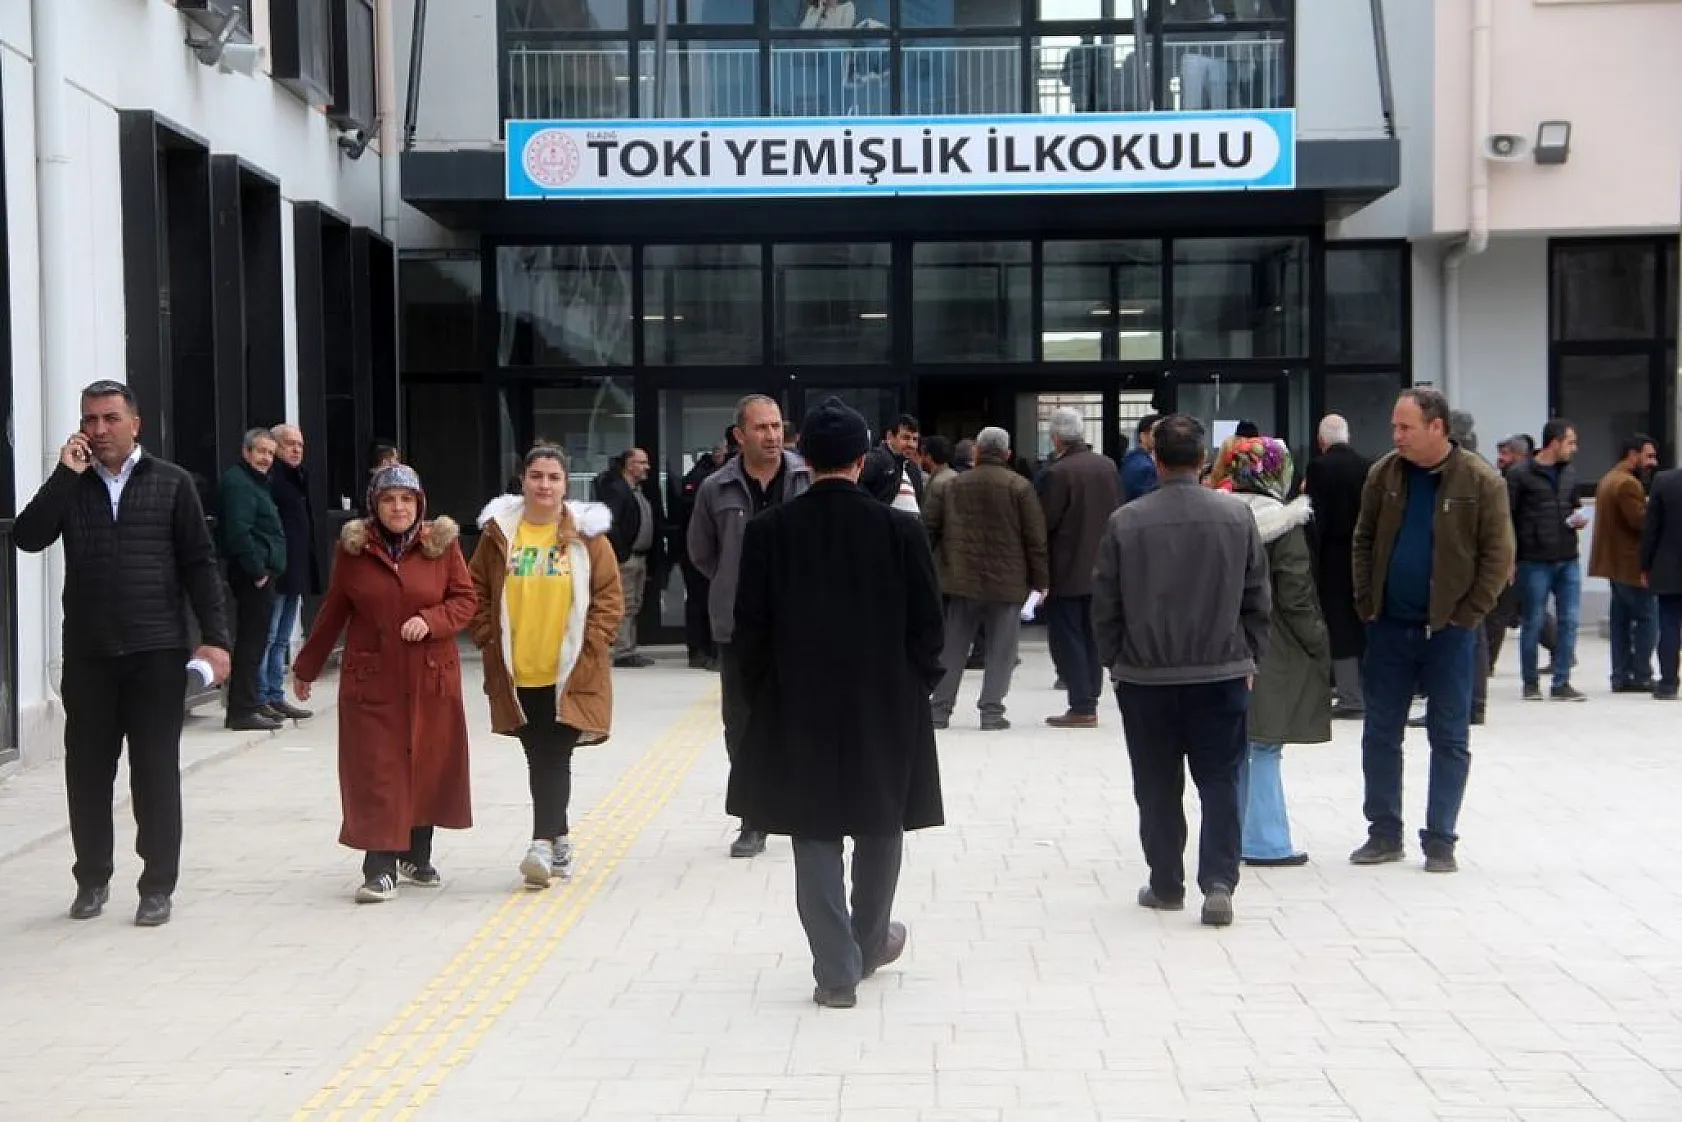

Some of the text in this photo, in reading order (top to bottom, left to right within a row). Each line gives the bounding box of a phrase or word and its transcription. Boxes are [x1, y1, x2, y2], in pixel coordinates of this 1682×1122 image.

[587, 128, 1253, 186] TOKİ YEMİŞLİK İLKOKULU
